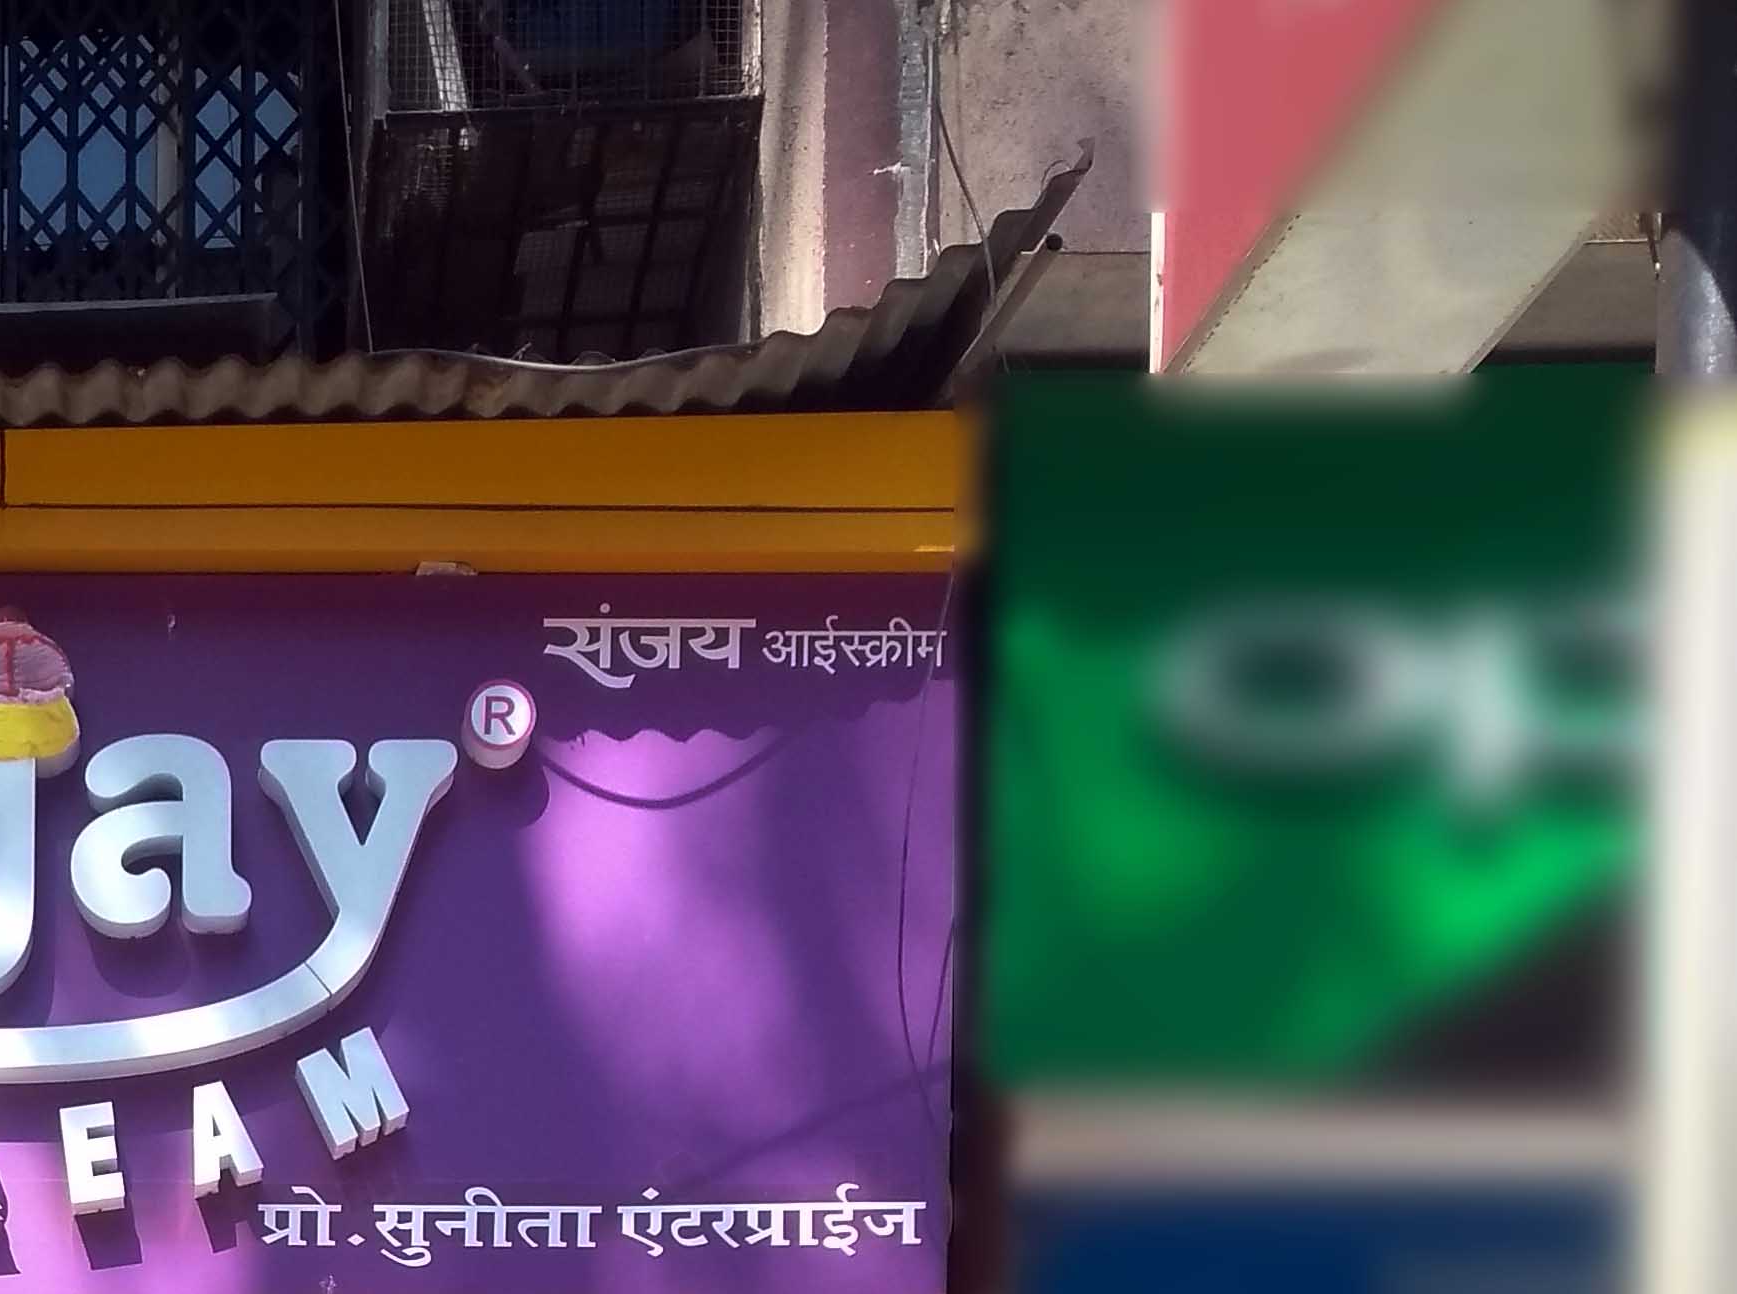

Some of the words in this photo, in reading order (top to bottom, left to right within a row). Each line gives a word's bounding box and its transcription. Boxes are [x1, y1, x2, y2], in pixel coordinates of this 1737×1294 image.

[543, 603, 757, 688] संजय
[762, 615, 947, 675] आईस्क्रीम
[617, 1184, 926, 1257] एंटरप्राईज
